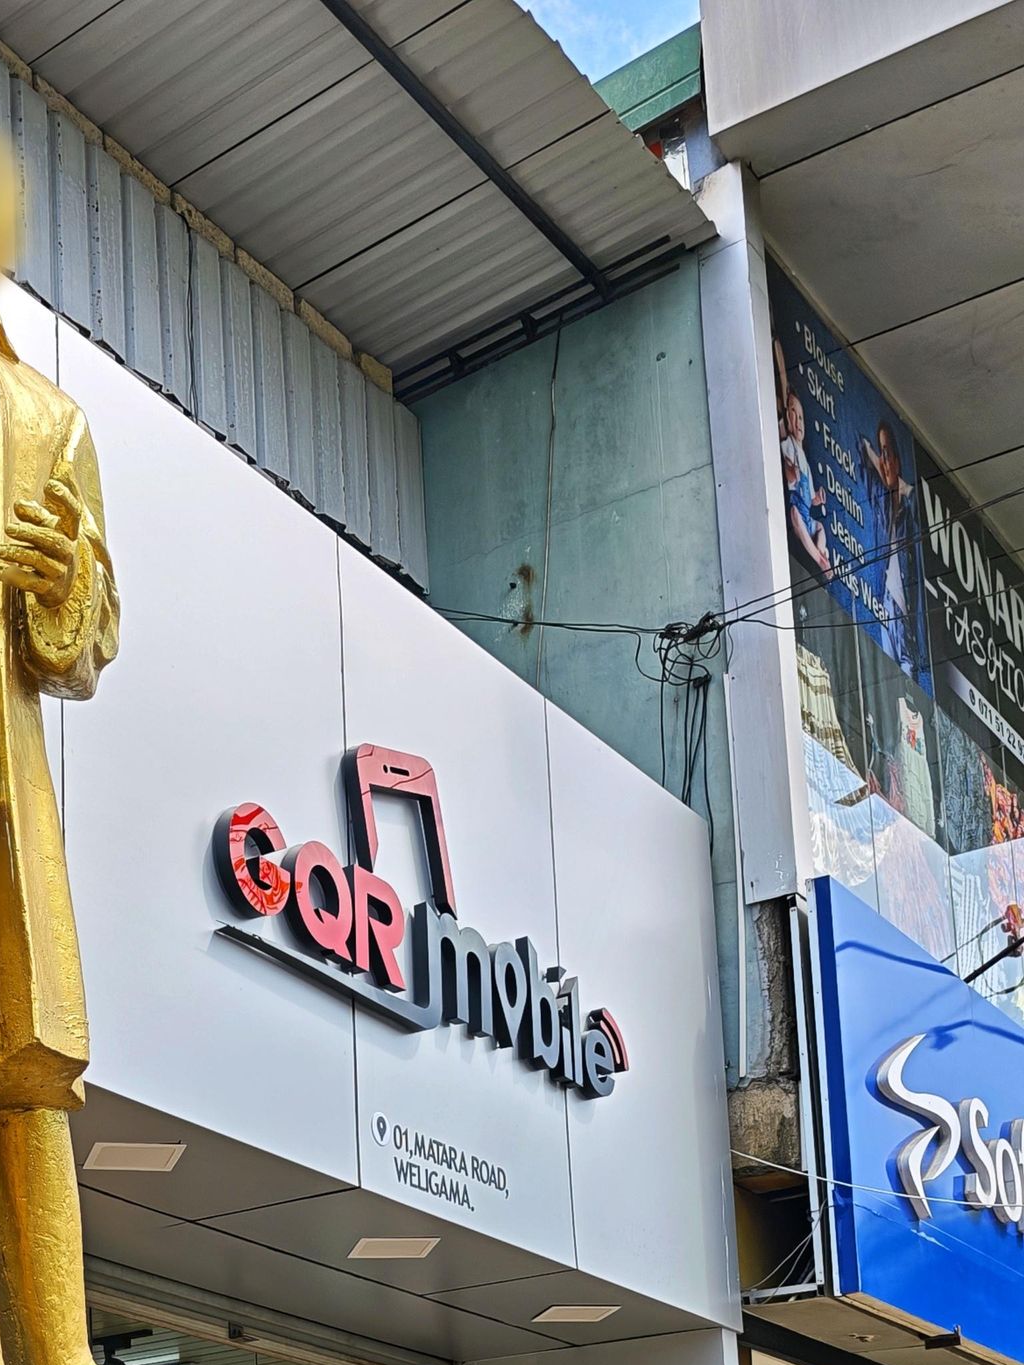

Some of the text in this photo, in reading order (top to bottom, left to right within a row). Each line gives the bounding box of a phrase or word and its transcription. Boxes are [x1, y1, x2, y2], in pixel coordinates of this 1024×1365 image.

[803, 325, 844, 393] Blouse
[807, 366, 835, 421] Skirt
[822, 422, 857, 483] Frock
[825, 463, 864, 527] Denim
[829, 511, 865, 565] Jeans
[832, 548, 891, 629] Kids Wear
[212, 801, 617, 1100] GQR mobile
[394, 1156, 475, 1212] WELIGAMA.
[471, 1155, 509, 1199] ROAD,
